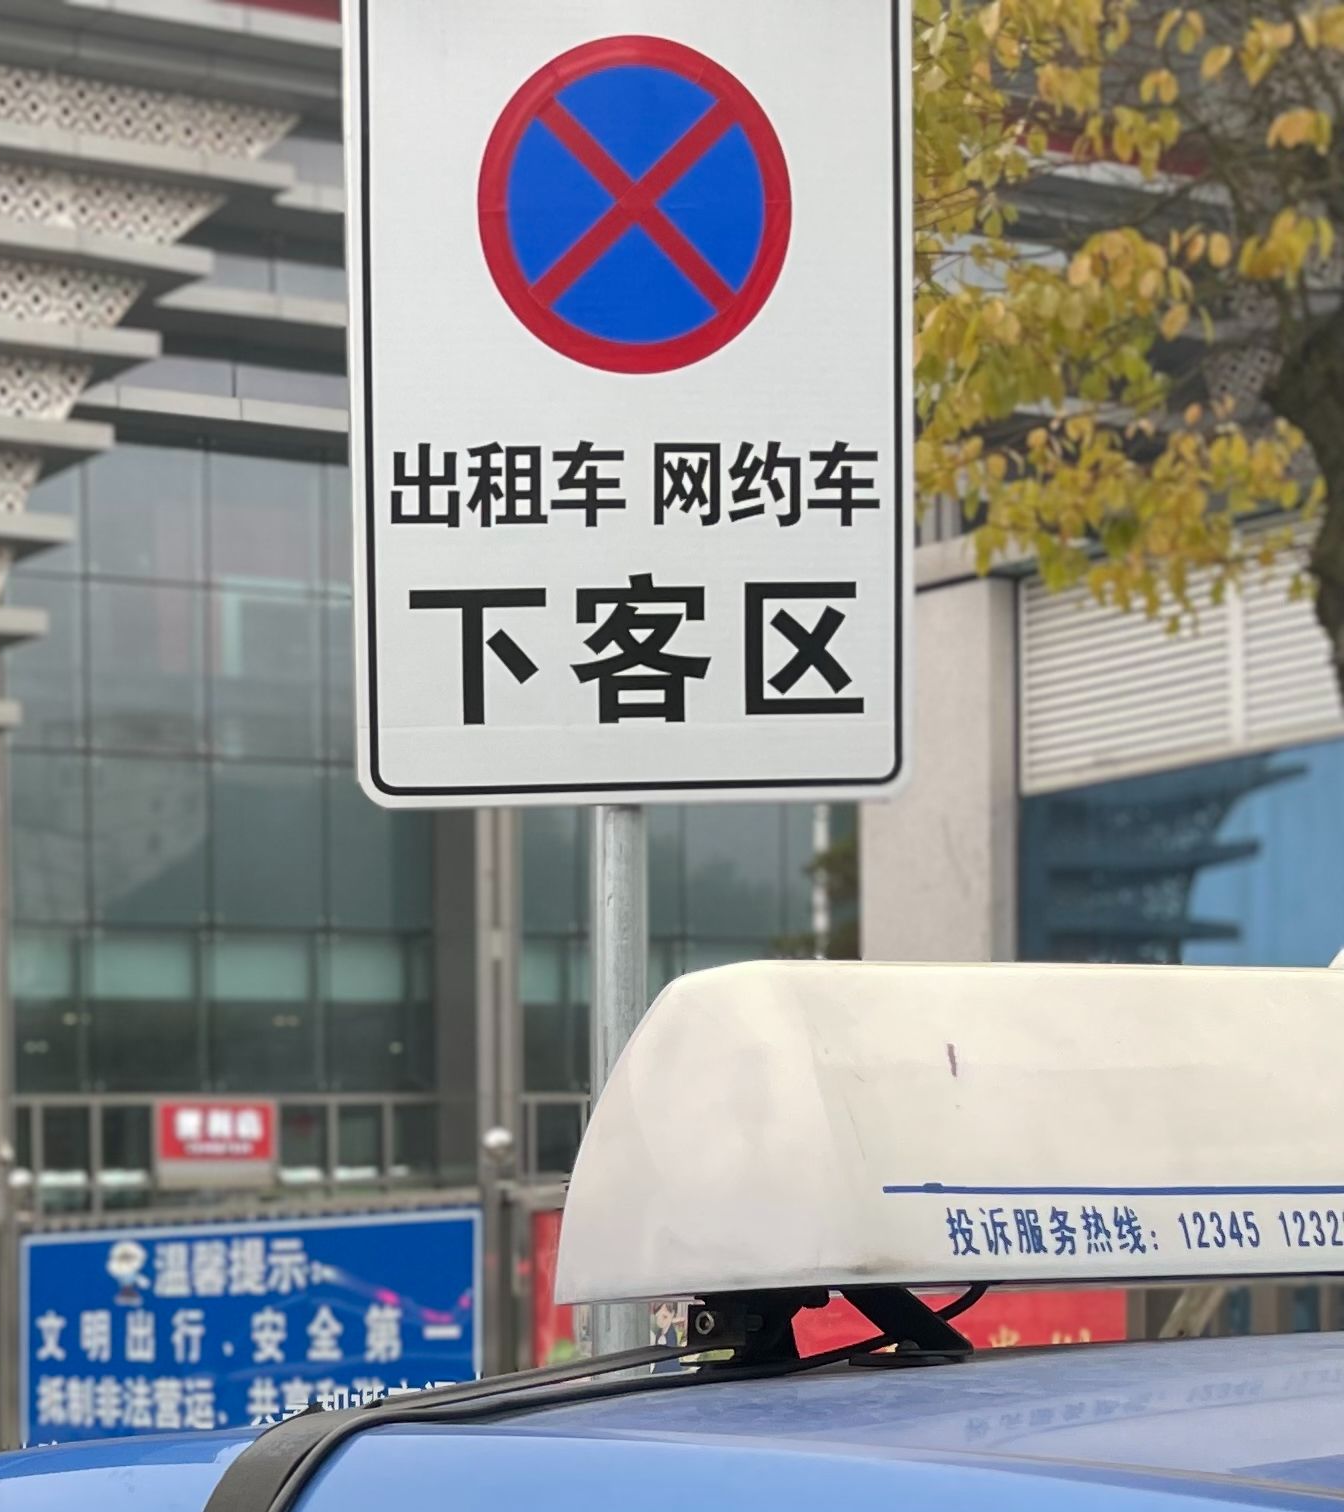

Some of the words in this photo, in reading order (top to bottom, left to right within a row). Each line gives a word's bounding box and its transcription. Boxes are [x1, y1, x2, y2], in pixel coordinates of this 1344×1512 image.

[390, 441, 627, 529] 出租车
[653, 440, 881, 527] 网约车
[408, 573, 865, 726] 下客区
[154, 1237, 309, 1297] 温馨提示
[945, 1205, 1161, 1256] 投诉服务热线:
[1178, 1210, 1261, 1249] 12345
[1278, 1209, 1344, 1248] 1232
